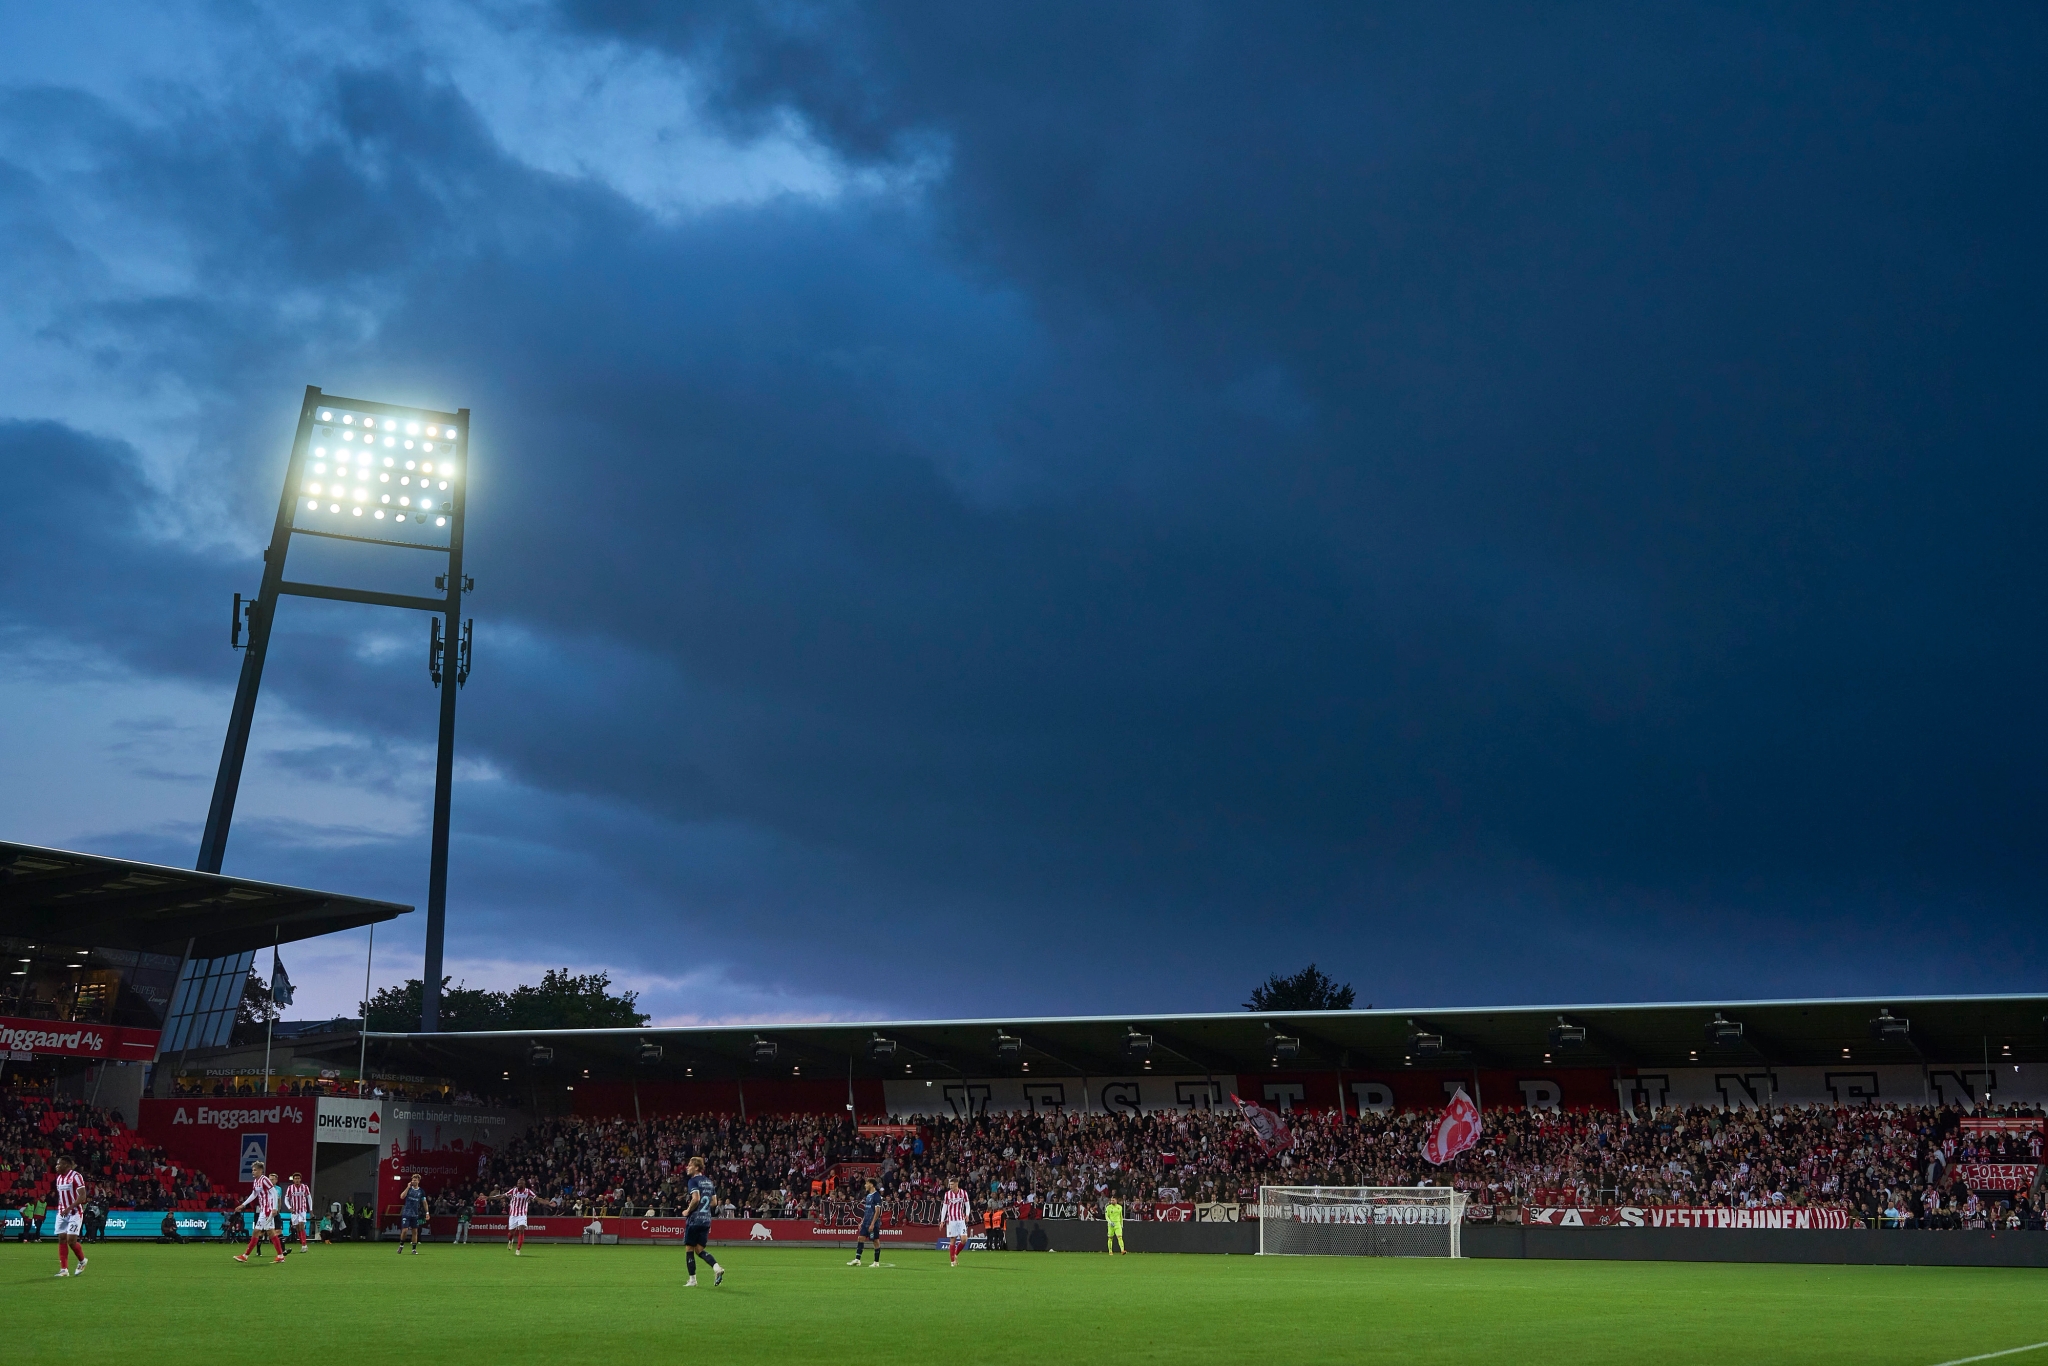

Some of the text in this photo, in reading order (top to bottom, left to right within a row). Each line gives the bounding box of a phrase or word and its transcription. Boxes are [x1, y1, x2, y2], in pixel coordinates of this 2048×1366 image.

[172, 1107, 194, 1124] A.
[197, 1105, 280, 1129] Enggaard
[393, 1108, 506, 1125] Cement binder byen sammen
[400, 1164, 458, 1175] aalborgportland
[1967, 1164, 2026, 1178] FORZA
[700, 1195, 710, 1213] 2
[1298, 1205, 1368, 1224] UNITAS
[1390, 1205, 1451, 1225] NORD
[176, 1219, 207, 1229] publicity
[813, 1227, 837, 1235] Cement
